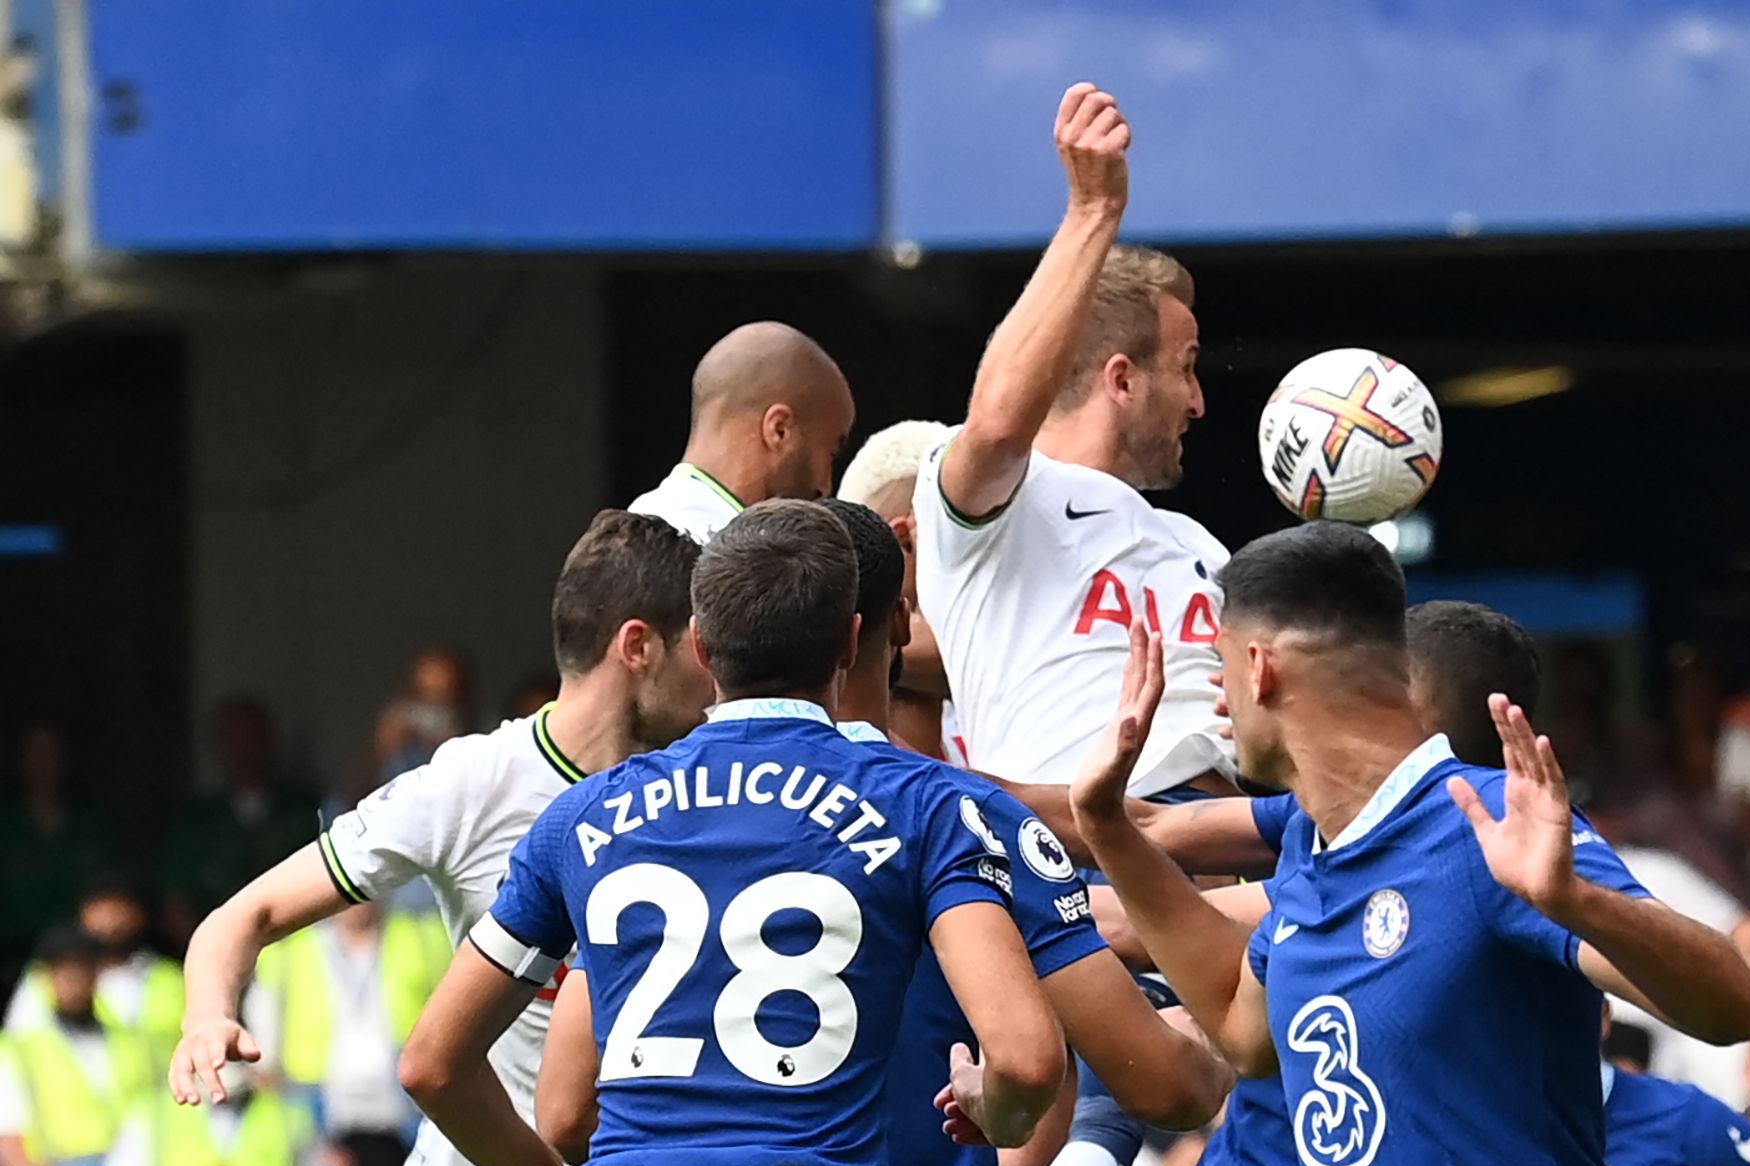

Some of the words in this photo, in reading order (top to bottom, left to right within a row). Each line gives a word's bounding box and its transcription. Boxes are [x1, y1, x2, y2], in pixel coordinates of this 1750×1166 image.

[1271, 413, 1310, 493] NIKE
[575, 761, 902, 876] AZPILICUETA
[586, 862, 863, 1086] 28
